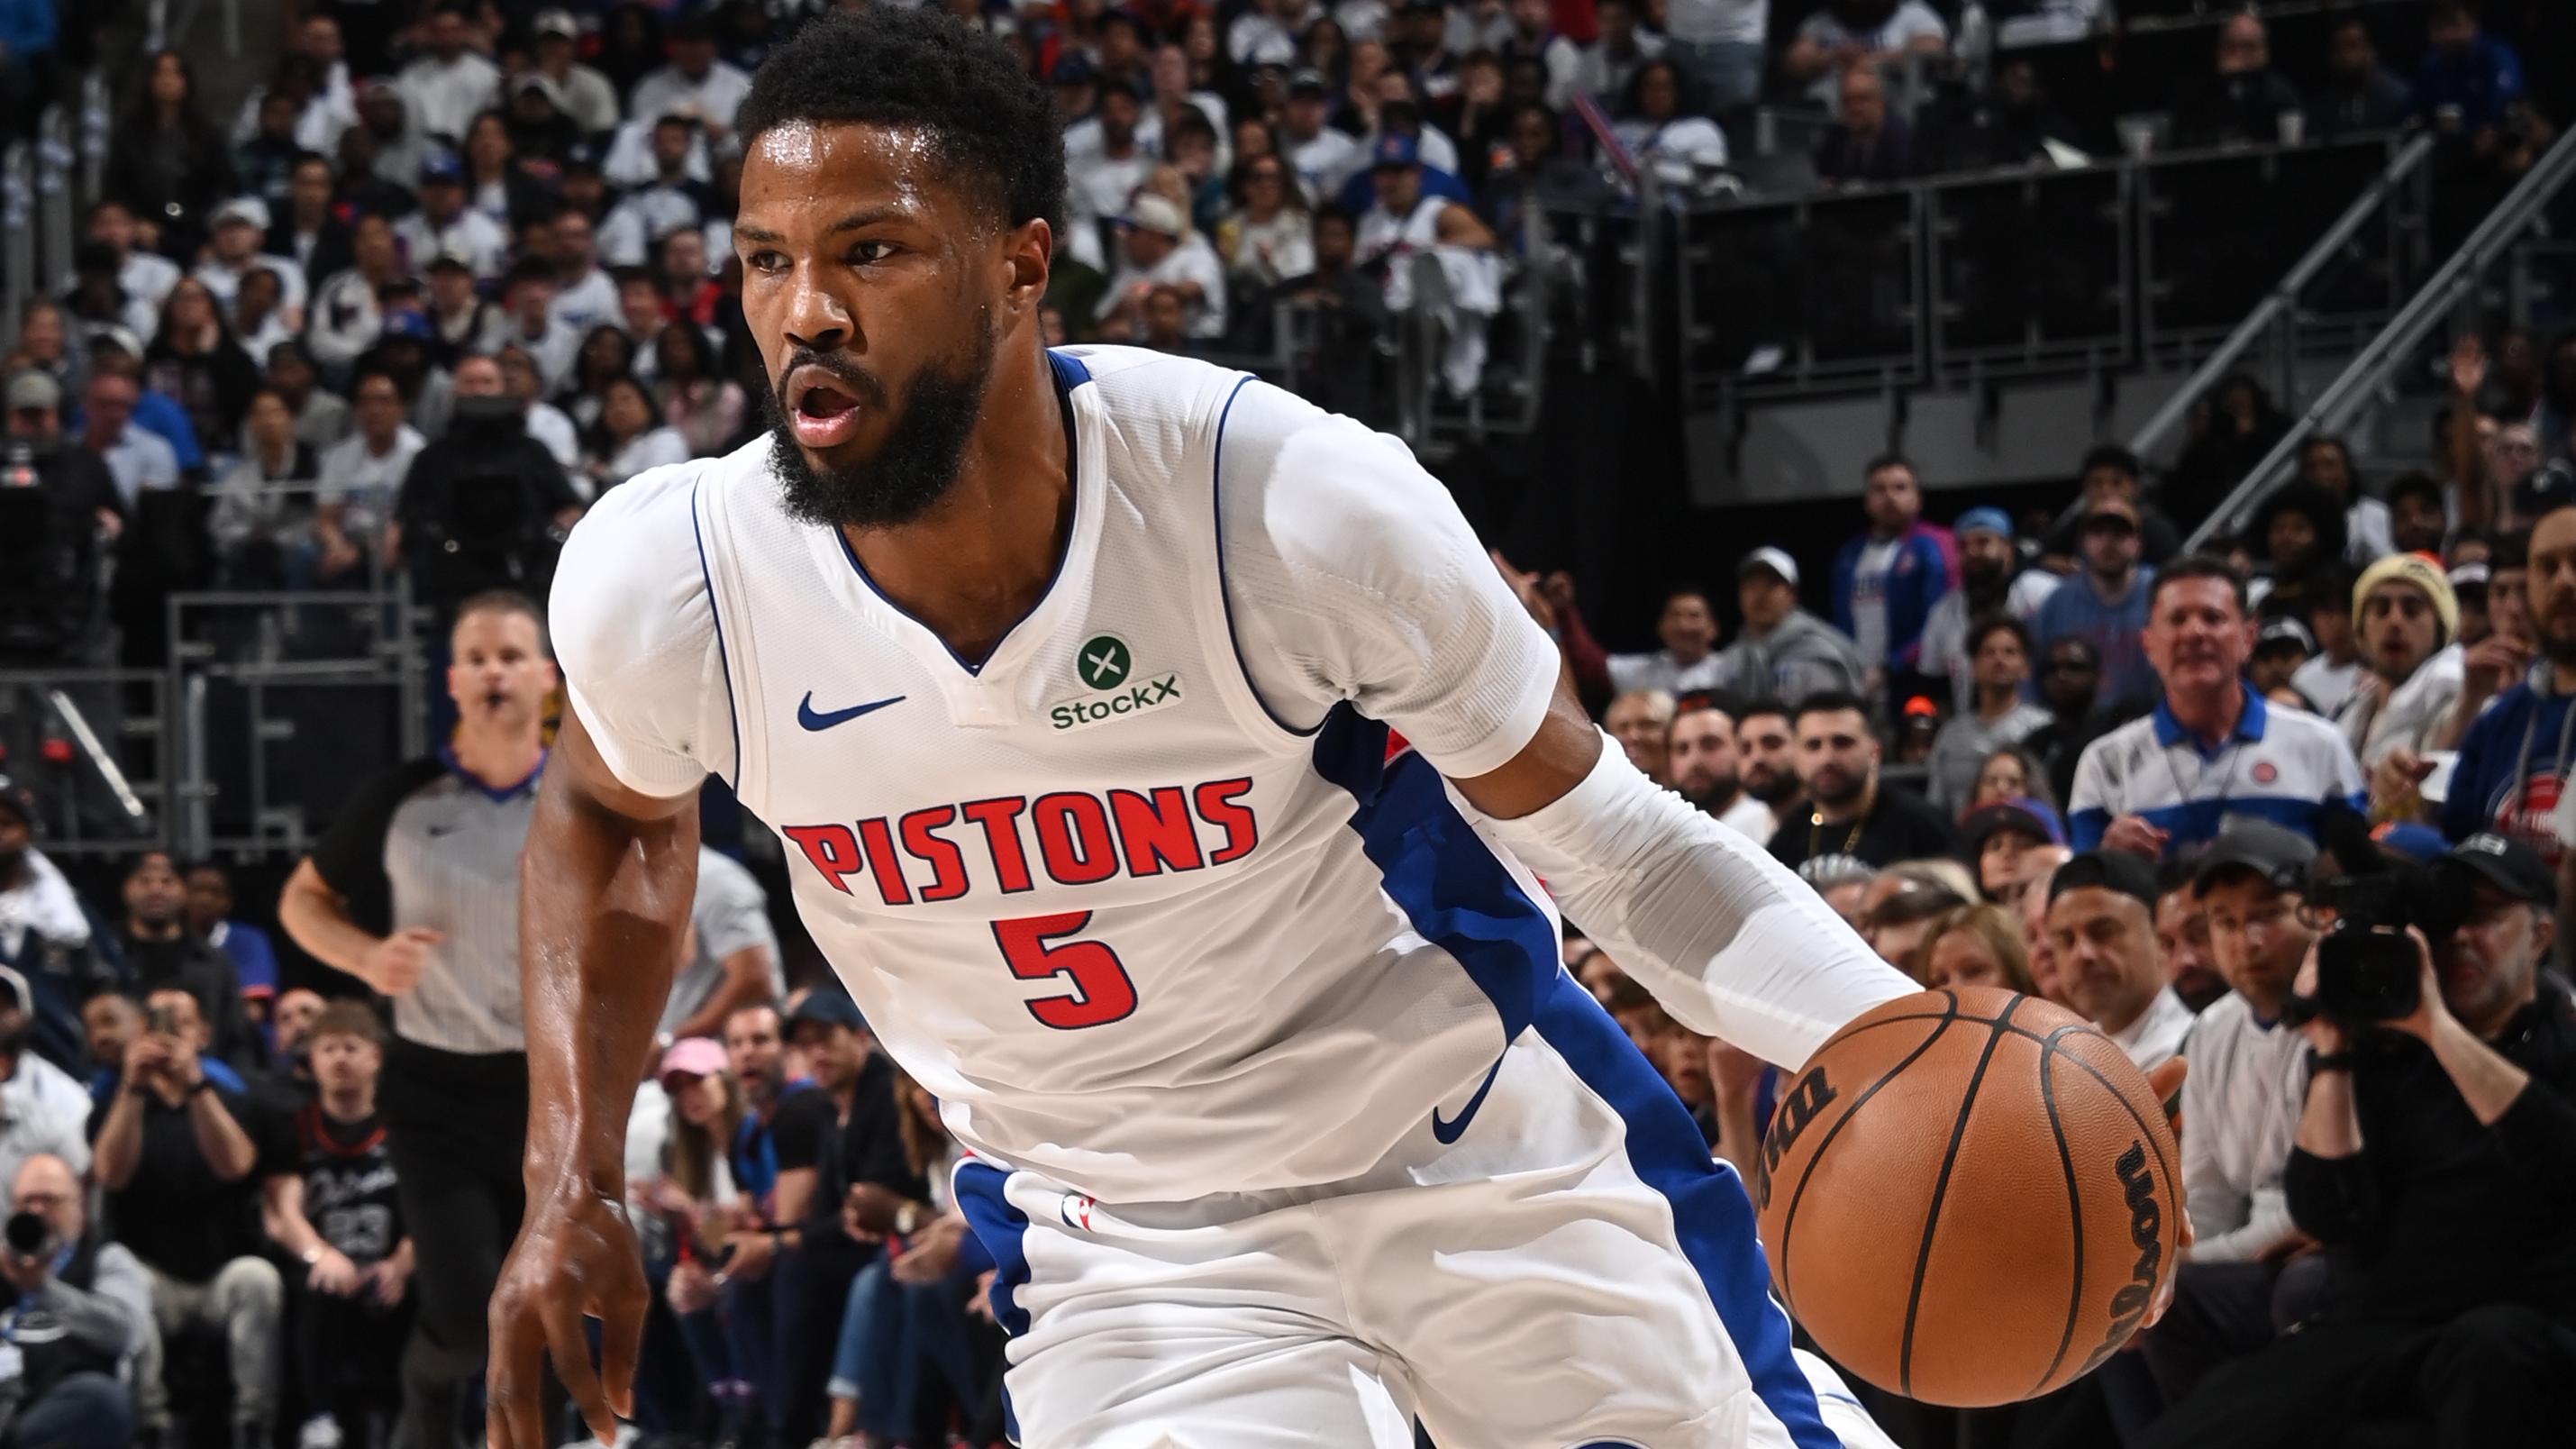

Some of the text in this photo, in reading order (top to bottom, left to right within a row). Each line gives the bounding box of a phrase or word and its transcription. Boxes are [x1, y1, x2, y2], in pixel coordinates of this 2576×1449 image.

[1050, 674, 1181, 729] StockX
[780, 776, 1259, 906] PISTONS
[989, 910, 1138, 1030] 5
